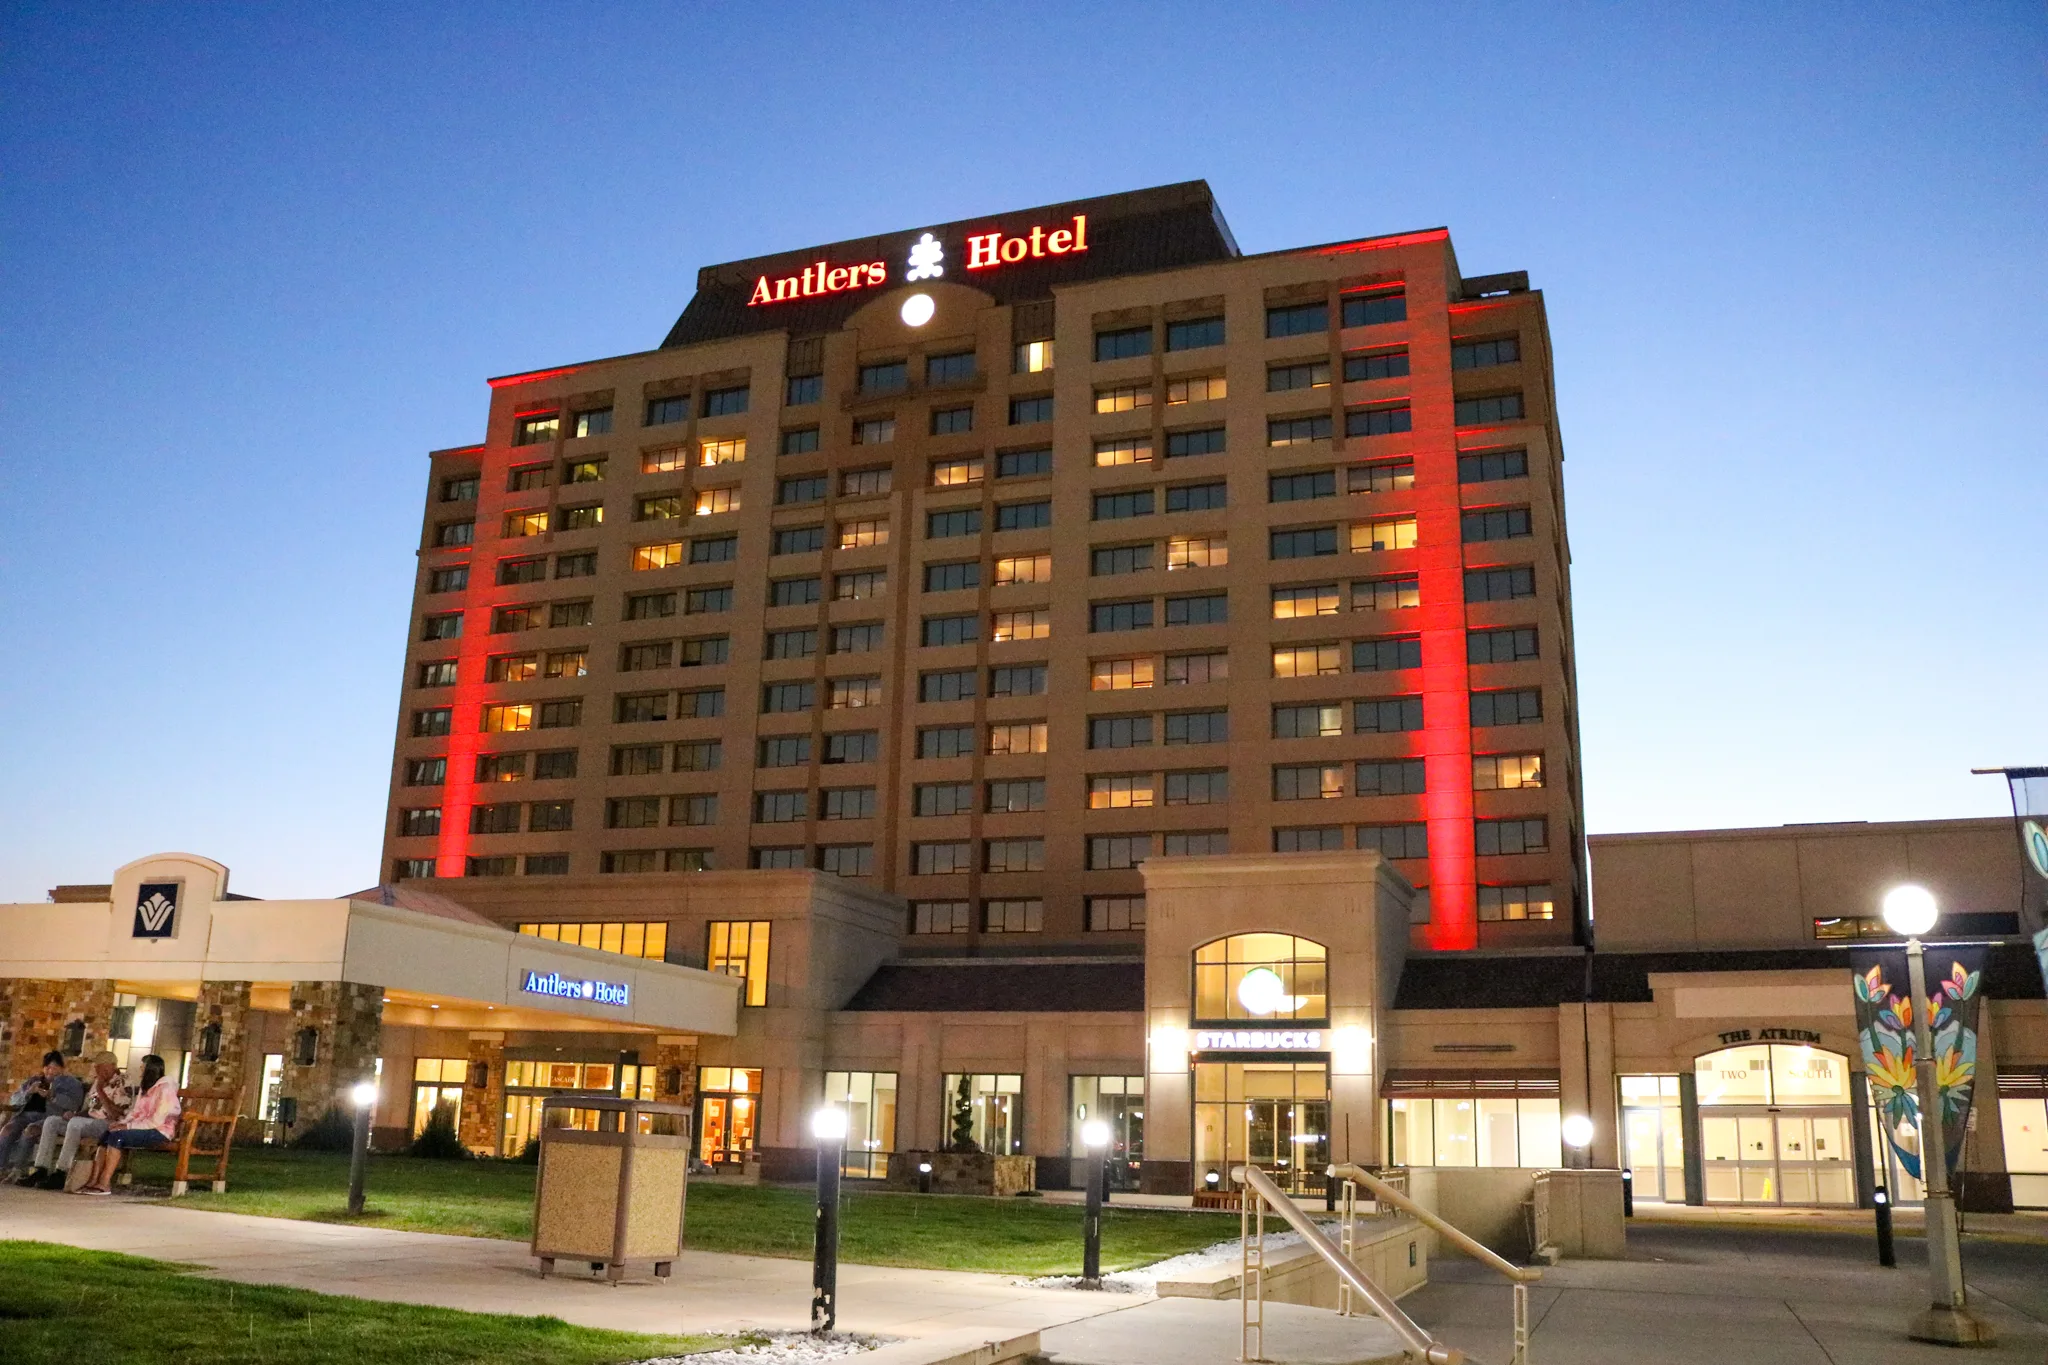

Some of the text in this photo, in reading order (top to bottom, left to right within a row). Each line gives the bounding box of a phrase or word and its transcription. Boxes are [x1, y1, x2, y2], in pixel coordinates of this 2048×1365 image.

[747, 215, 1088, 307] Antlers Hotel
[525, 971, 629, 1005] Antlers Hotel
[1197, 1031, 1320, 1049] STARBUCKS
[1718, 1028, 1821, 1044] THE ATRIUM
[1720, 1070, 1747, 1080] TWO
